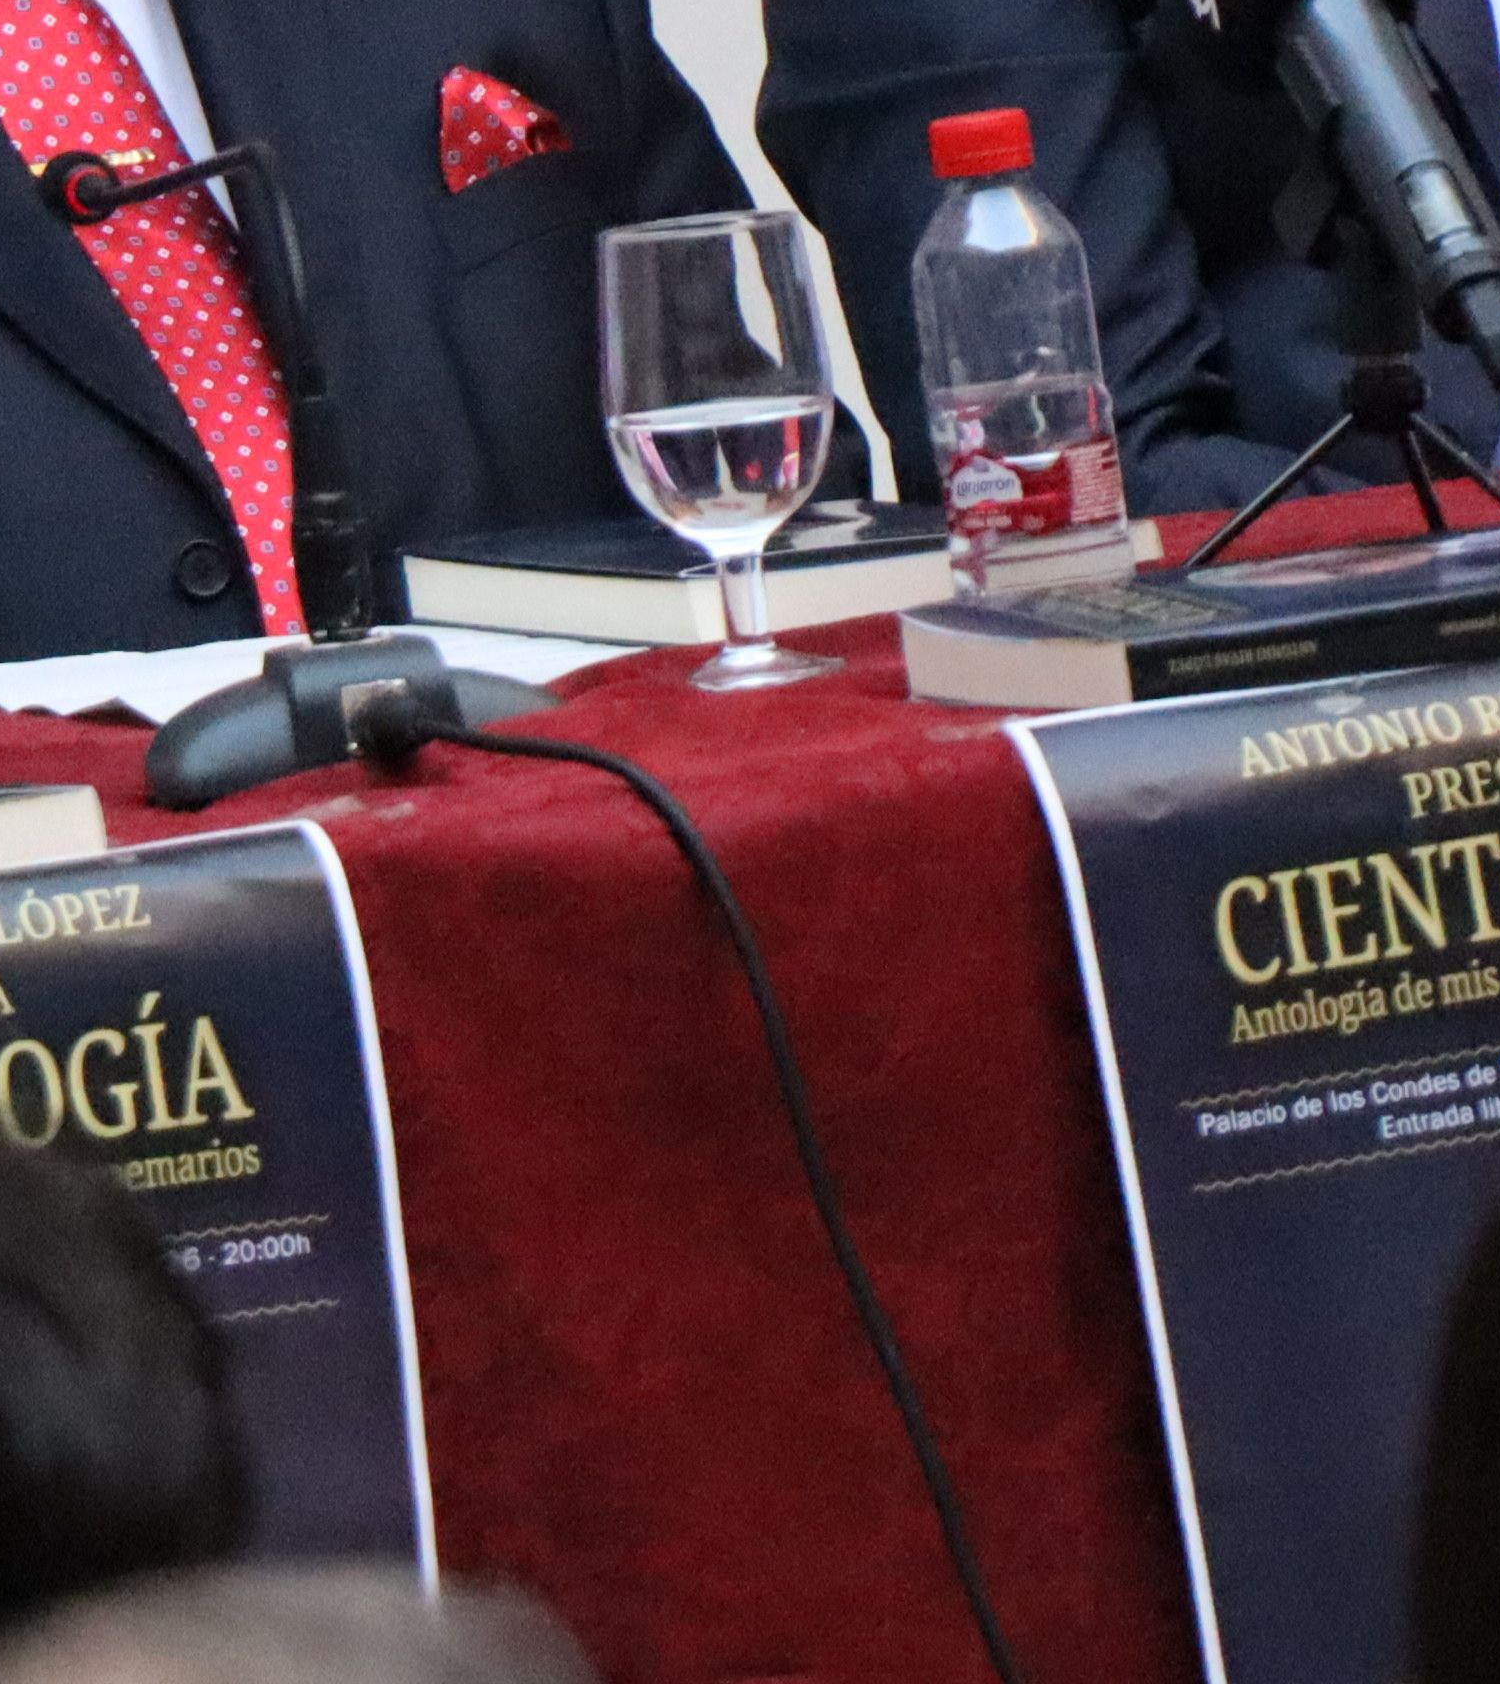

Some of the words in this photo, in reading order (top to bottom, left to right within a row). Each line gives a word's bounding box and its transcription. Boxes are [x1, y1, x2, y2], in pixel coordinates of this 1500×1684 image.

[1241, 701, 1464, 778] ANTONIO
[1231, 979, 1389, 1044] Antología
[1392, 972, 1435, 1013] de
[1438, 958, 1500, 1004] mis
[1199, 1102, 1287, 1136] Palacio
[1292, 1096, 1323, 1120] de
[1327, 1089, 1366, 1112] los
[1369, 1072, 1460, 1105] Condes
[1465, 1065, 1497, 1088] de
[1380, 1108, 1474, 1140] Entrada
[122, 1139, 262, 1192] emarios
[223, 1234, 311, 1267] 20:00h
